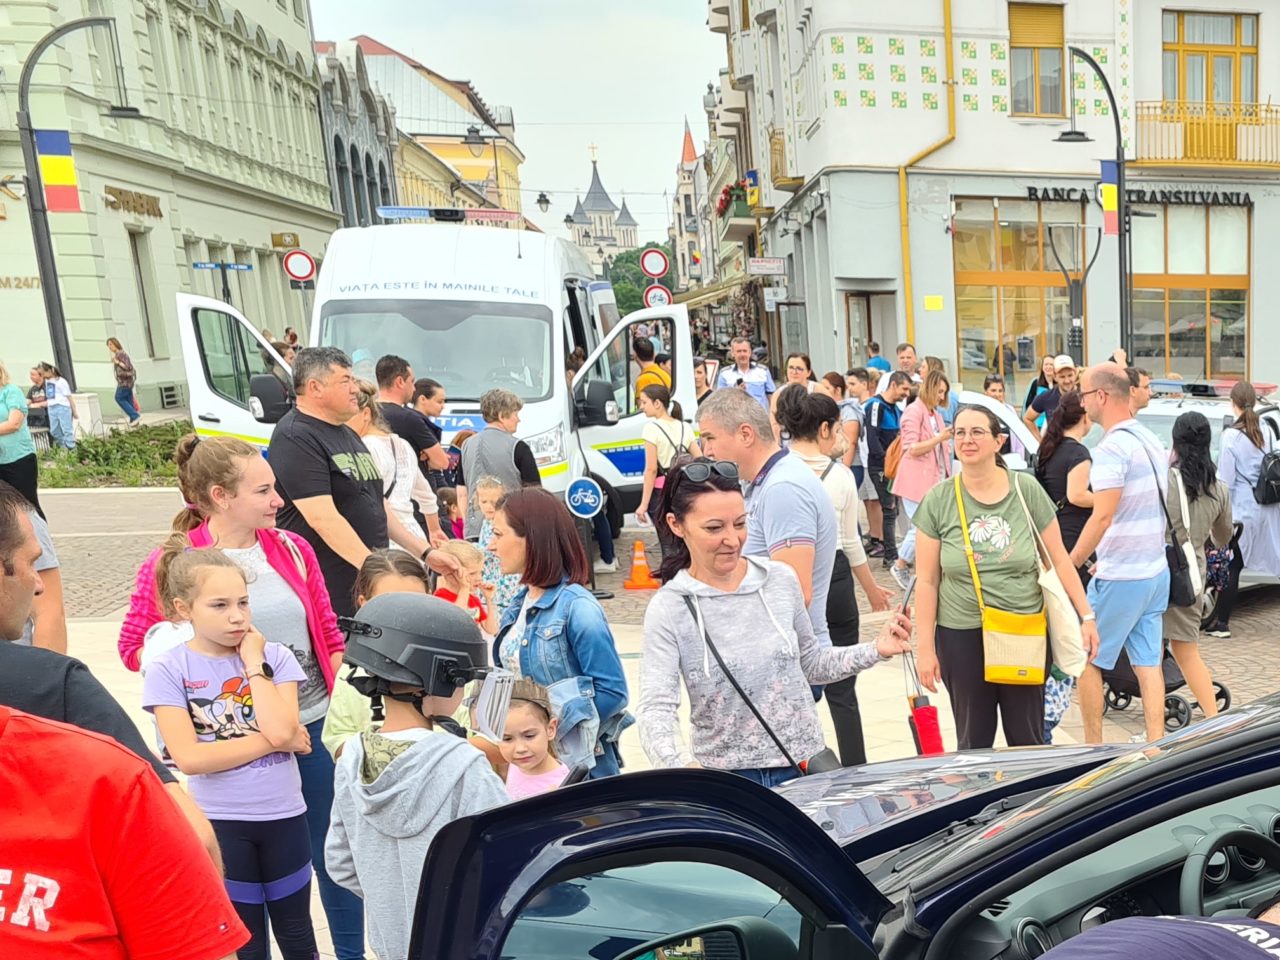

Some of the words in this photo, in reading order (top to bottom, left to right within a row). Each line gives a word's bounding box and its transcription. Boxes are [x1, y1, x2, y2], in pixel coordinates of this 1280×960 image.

[1027, 187, 1089, 203] BANCA
[1126, 189, 1254, 207] TRANSILVANIA
[0, 276, 11, 288] M
[383, 281, 420, 290] ESTE
[442, 282, 501, 293] MAINILE
[503, 286, 540, 299] TALE
